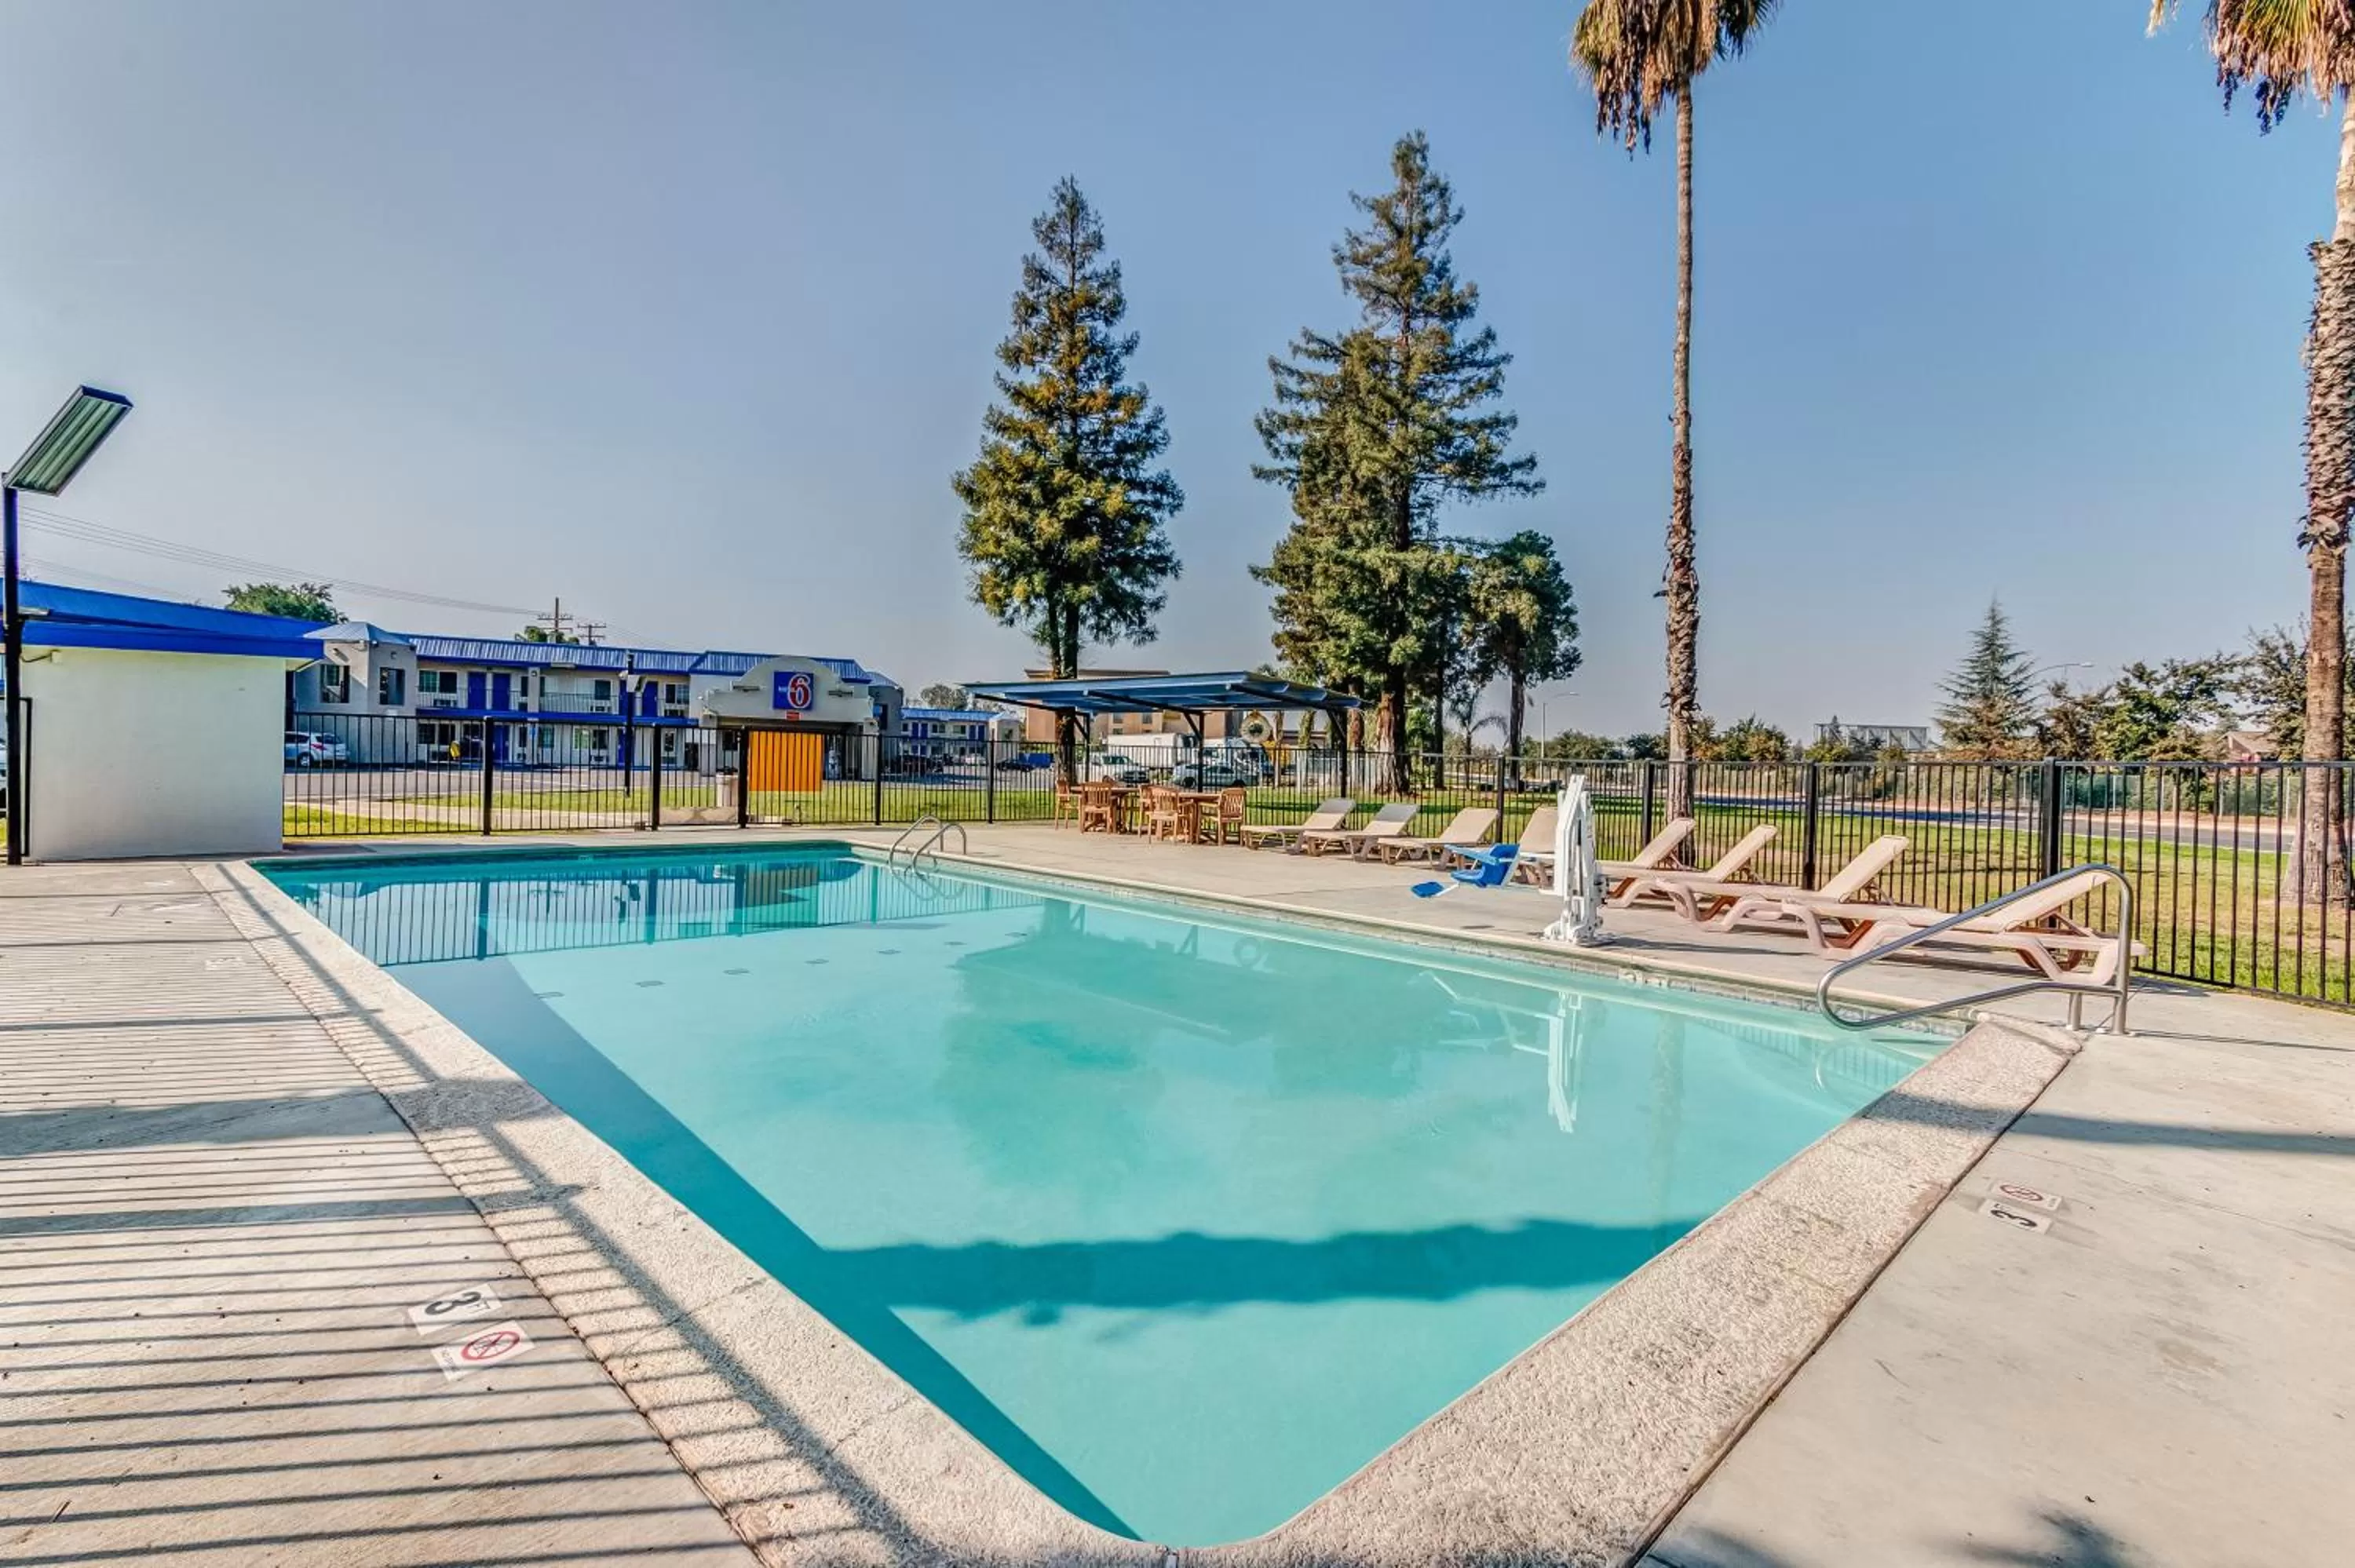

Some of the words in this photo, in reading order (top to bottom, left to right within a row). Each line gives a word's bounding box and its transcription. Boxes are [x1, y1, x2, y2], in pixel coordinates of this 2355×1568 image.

[787, 673, 811, 709] 6
[1990, 1209, 2038, 1227] 3
[425, 1291, 481, 1315] 3
